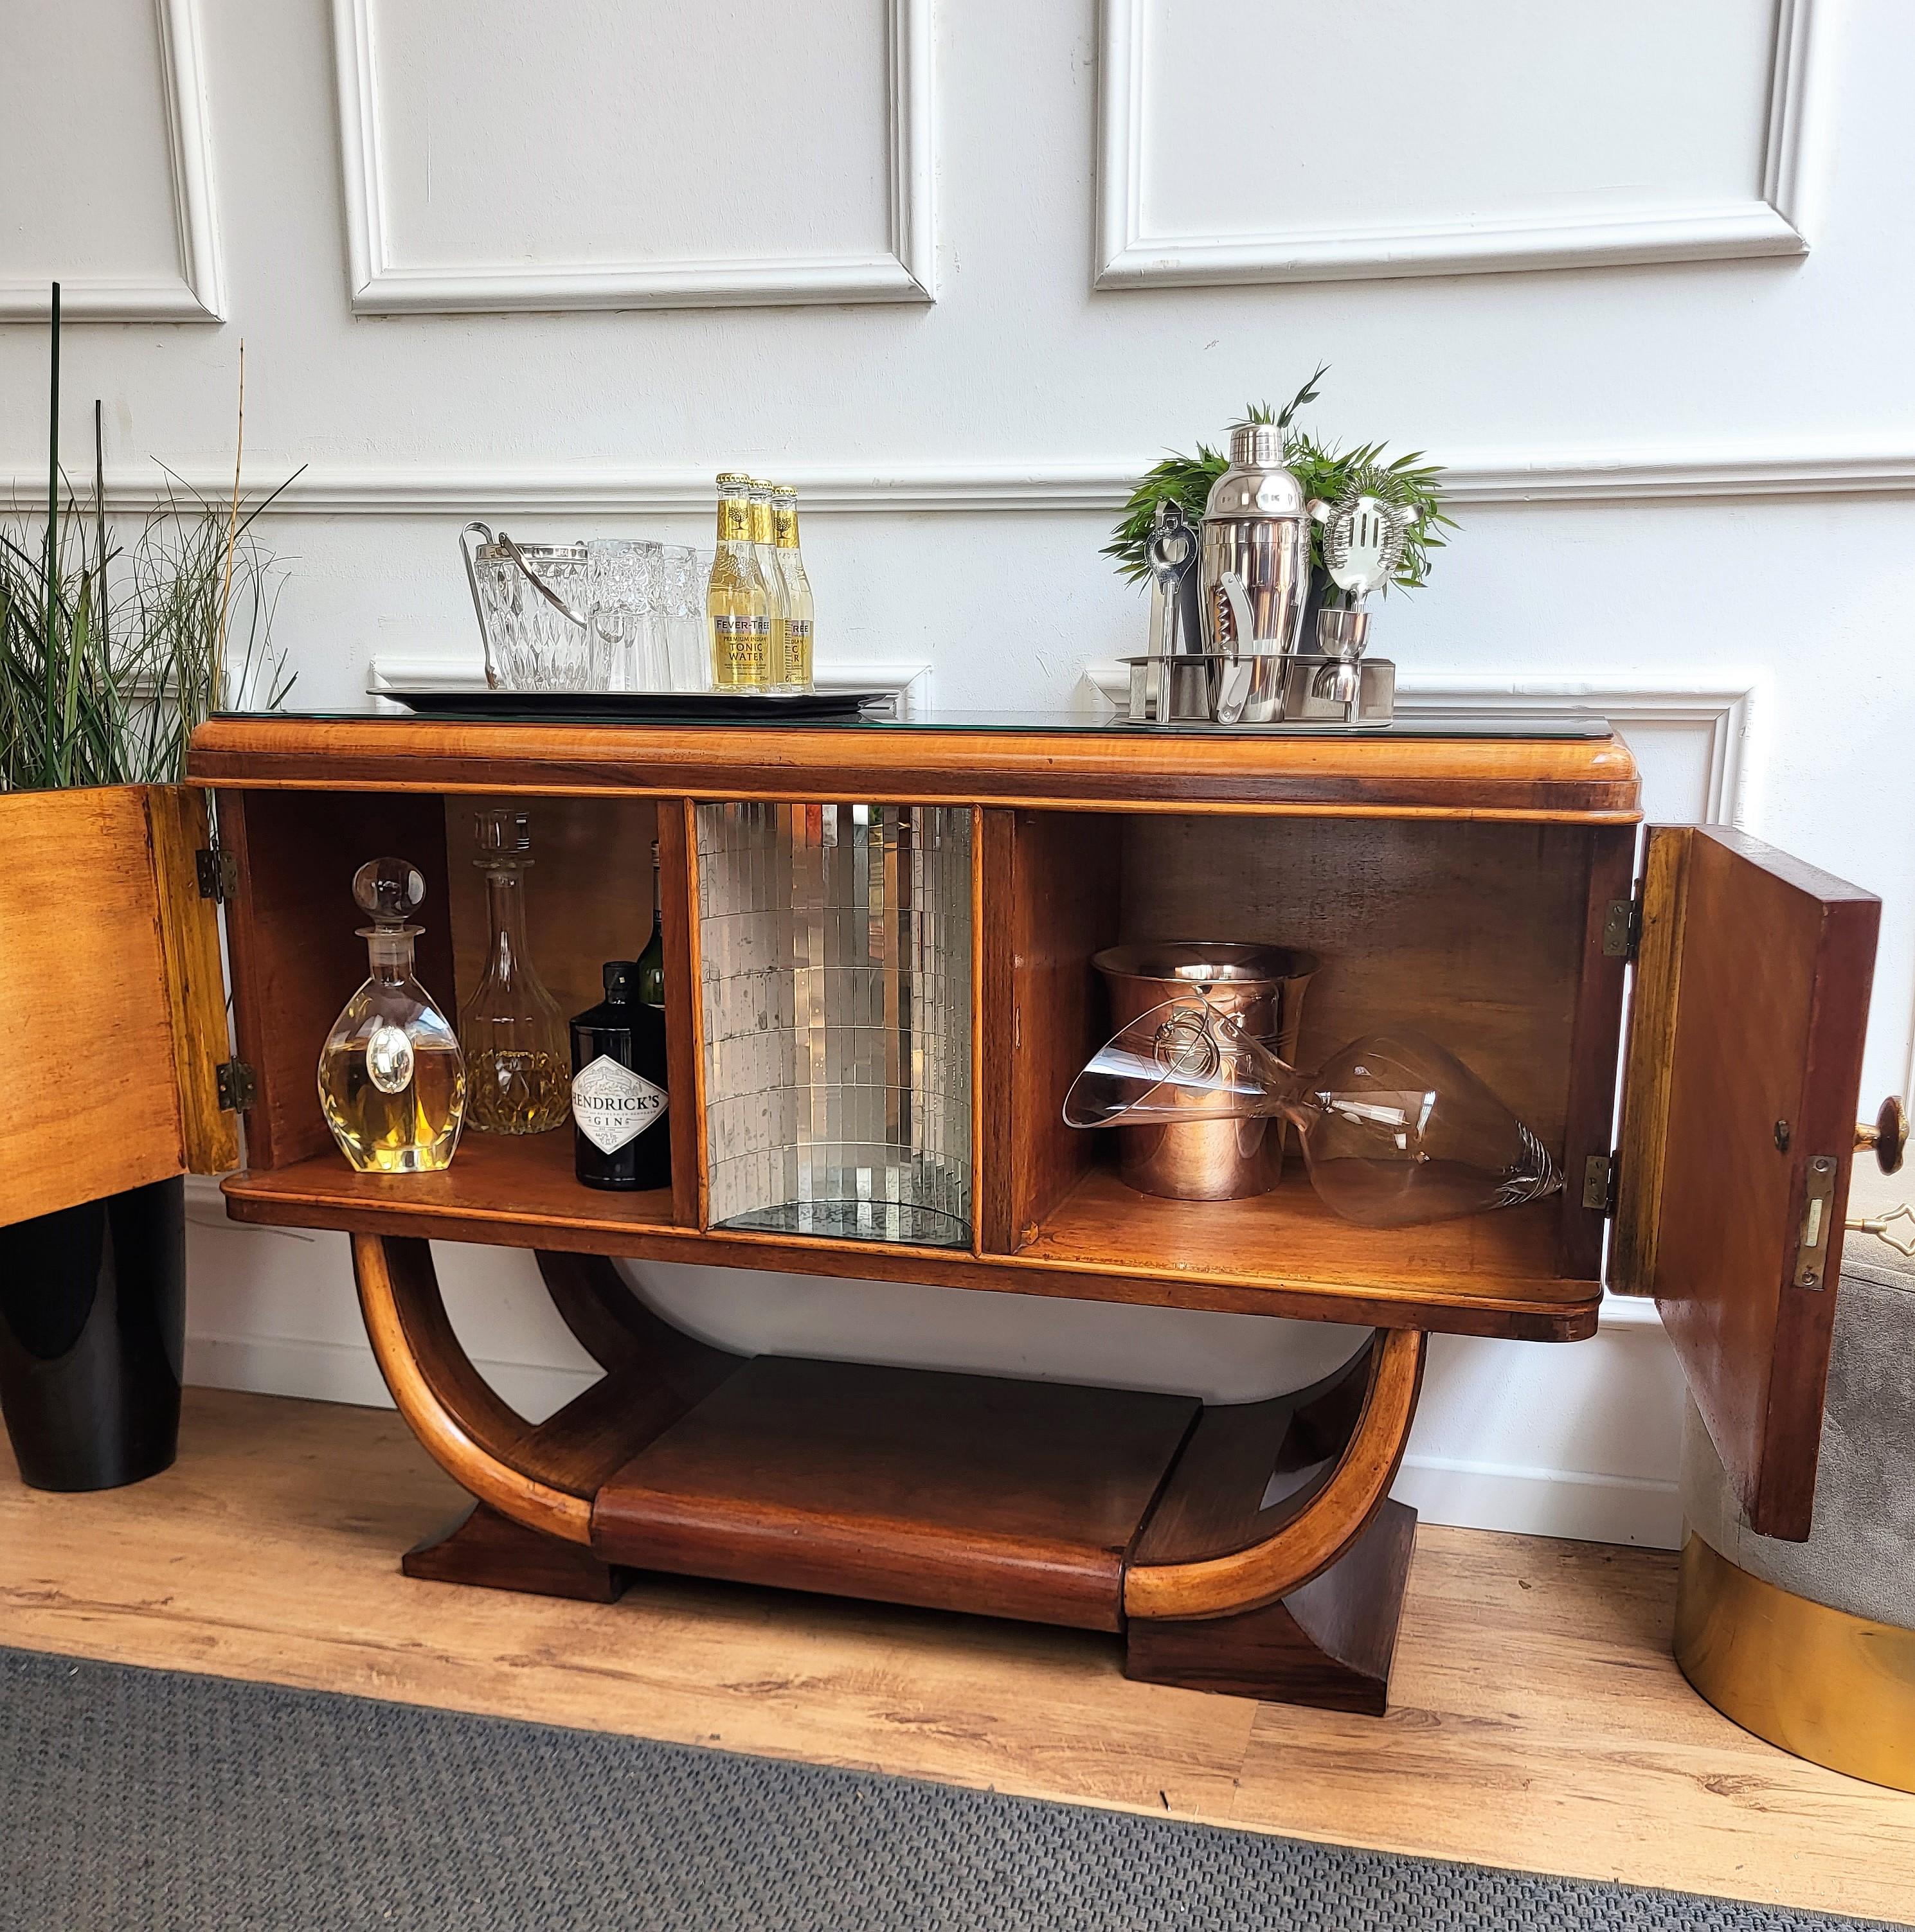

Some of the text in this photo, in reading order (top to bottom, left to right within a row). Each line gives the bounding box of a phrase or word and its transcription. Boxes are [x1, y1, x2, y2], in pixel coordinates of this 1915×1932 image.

[717, 620, 769, 630] FEVER-TREE
[791, 623, 809, 632] REE
[730, 643, 763, 652] TONIC
[729, 652, 764, 661] WATER
[573, 1092, 660, 1111] HENDRICK'S
[594, 1116, 623, 1126] GIN
